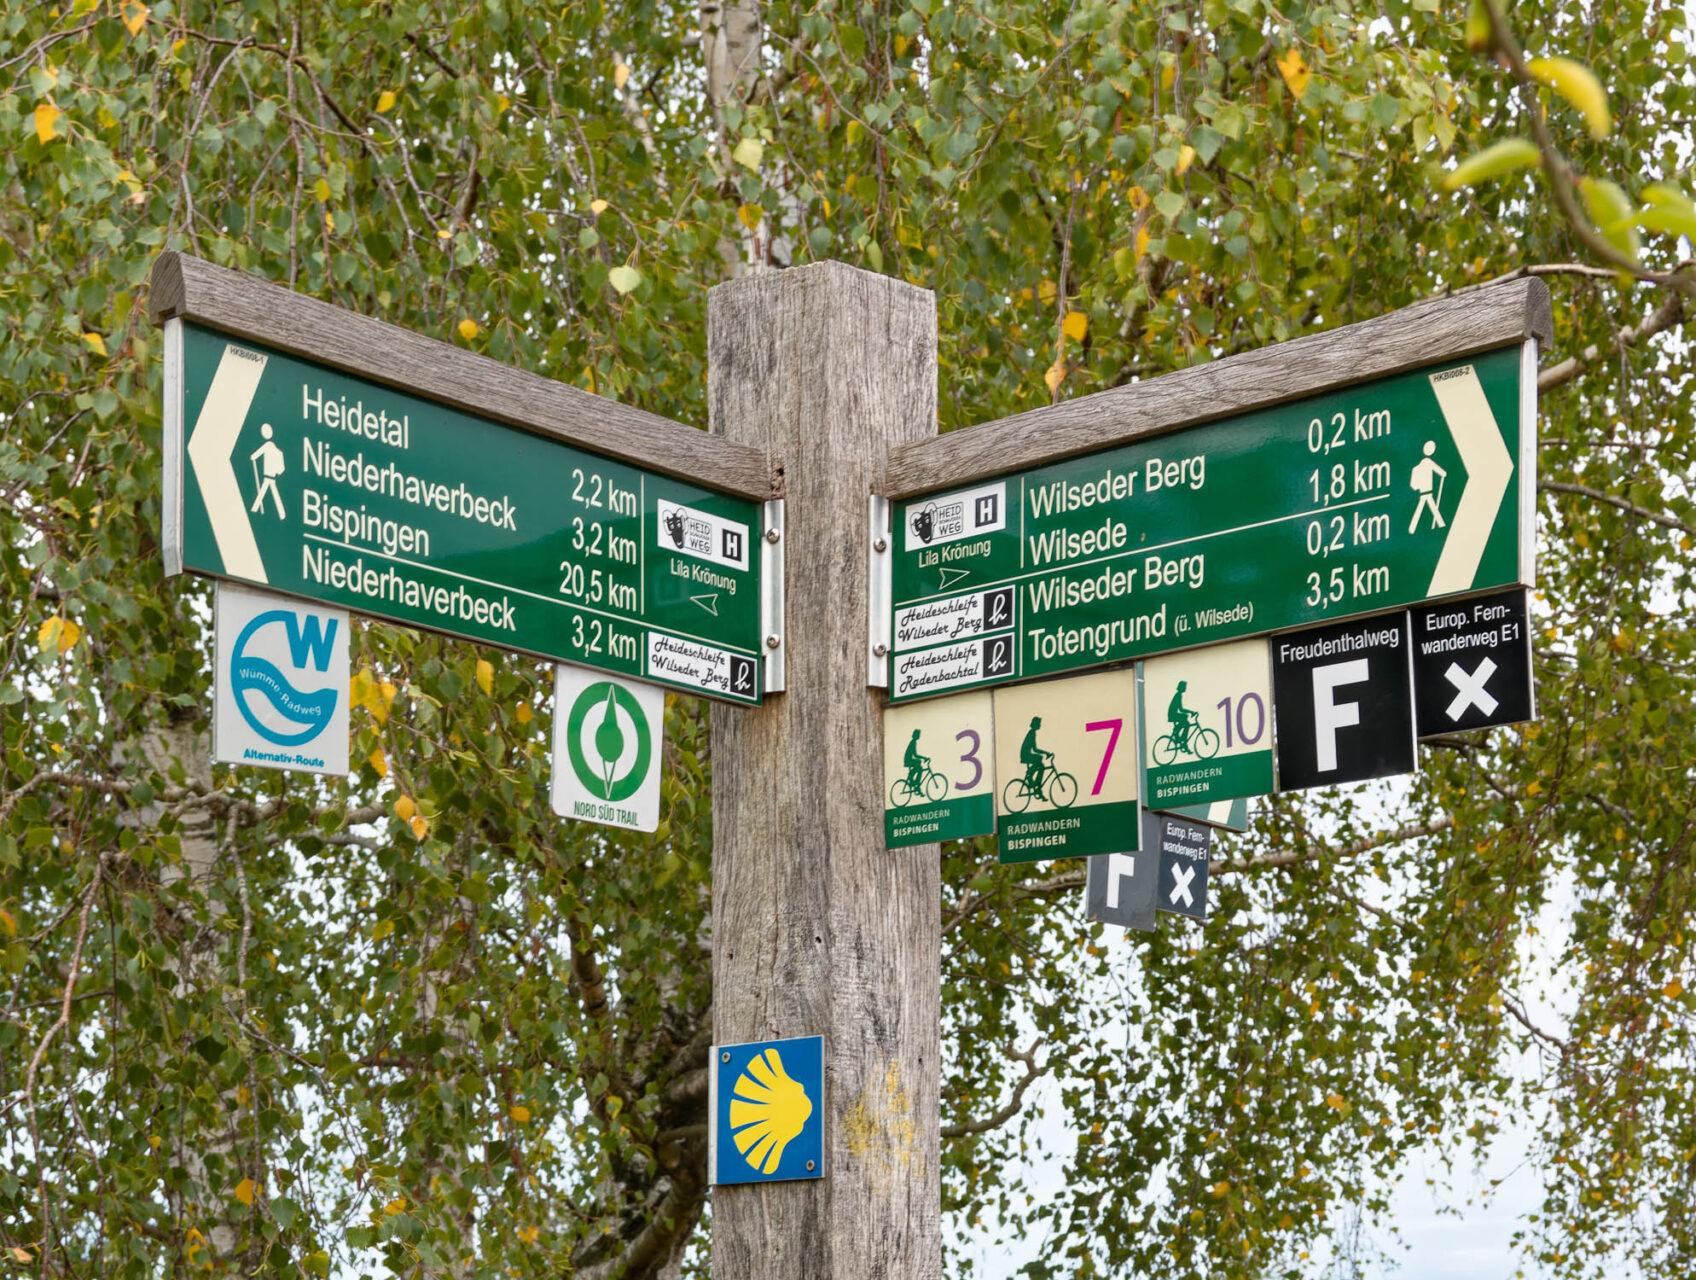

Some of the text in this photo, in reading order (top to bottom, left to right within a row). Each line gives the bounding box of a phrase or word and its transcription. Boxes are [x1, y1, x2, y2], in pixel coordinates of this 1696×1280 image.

[303, 384, 636, 518] Heidetal 2,2 km
[1030, 408, 1391, 520] Wilseder Berg 0,2 km
[303, 437, 636, 565] Niederhaverbeck 3,2 km
[939, 504, 962, 520] HEID
[980, 498, 993, 524] H
[1029, 459, 1391, 567] Wilsede 1,8 km
[690, 522, 711, 535] HEID
[939, 521, 961, 535] WEG
[303, 489, 636, 612] Bispingen 20,5 km
[690, 538, 710, 551] WEG
[726, 532, 738, 557] H
[918, 538, 992, 569] Lila Krönung
[670, 557, 736, 595] Lila Krönung
[1029, 511, 1390, 614] Wilseder Berg 0,2 km
[303, 544, 636, 661] Niederhaverbeck 3,2 km
[900, 595, 978, 627] Heideschleife
[1028, 563, 1390, 661] Totengrund (ü. Wilsede) 3,5 km
[1426, 604, 1511, 632] Europ. Fern-
[898, 616, 983, 642] Wilseder Berg
[1421, 623, 1520, 655] wanderweg E1
[654, 637, 725, 669] Heideschleife
[900, 643, 978, 675] Heideschleife
[1280, 627, 1400, 664] Freudenthalweg
[651, 654, 729, 690] Wilseder Berg
[899, 662, 980, 693] Radenbachtal
[1216, 692, 1266, 748] 10
[1312, 658, 1369, 773] F
[243, 748, 325, 768] Alternativ-Route
[955, 729, 983, 791] 3
[1085, 718, 1124, 796] 7
[1156, 767, 1224, 786] RADWANDERN
[1156, 782, 1210, 799] BISPINGEN
[573, 800, 639, 826] NORD SÜD TRAIL
[893, 808, 950, 826] RADWANDERN
[1007, 818, 1081, 836] RADWANDERN
[893, 822, 940, 838] BISPINGEN
[1008, 834, 1067, 851] BISPINGEN
